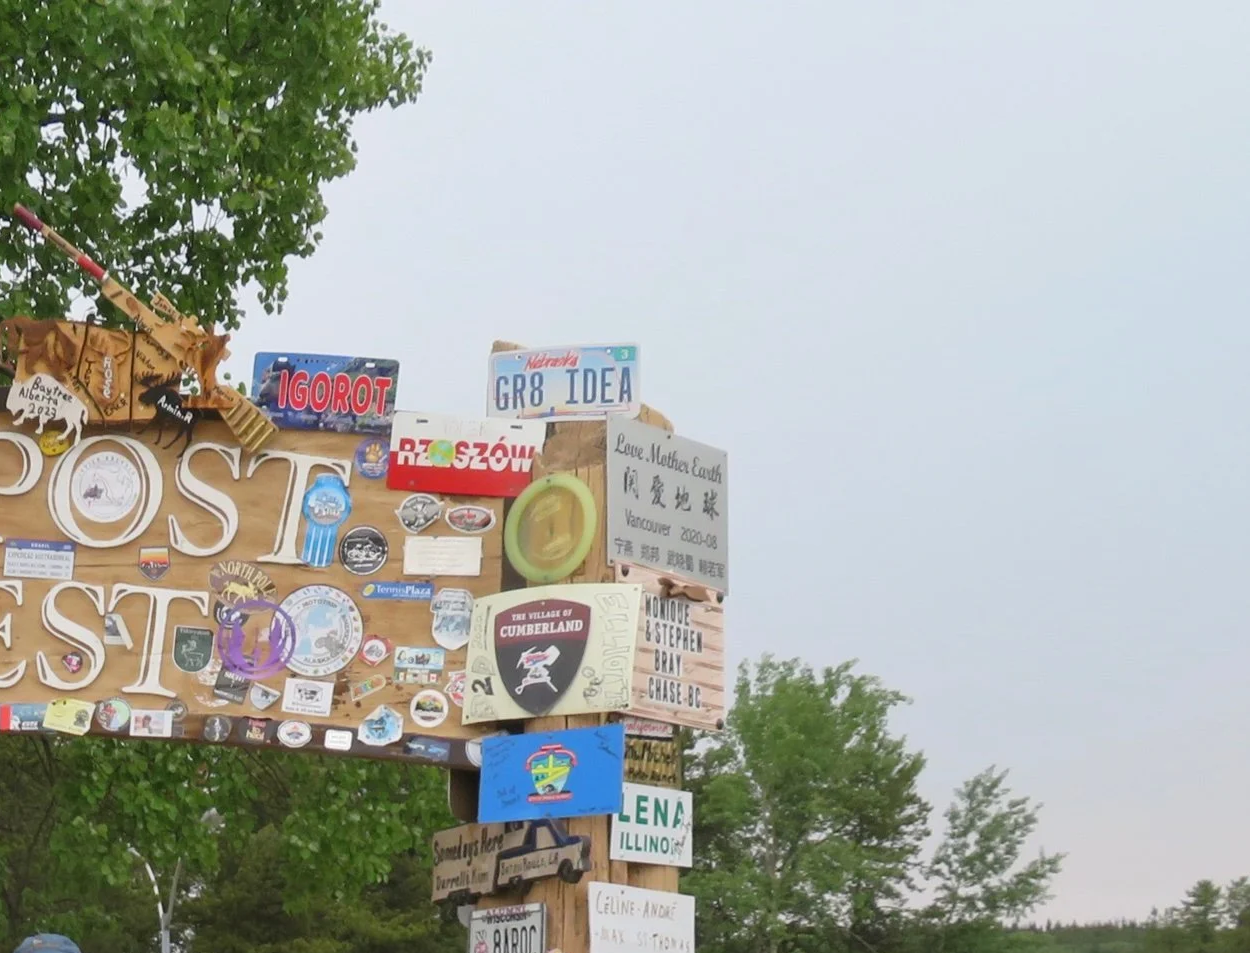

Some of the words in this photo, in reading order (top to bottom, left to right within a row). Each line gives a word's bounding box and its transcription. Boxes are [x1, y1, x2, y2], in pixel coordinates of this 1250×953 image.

[524, 351, 580, 371] Nebraska
[277, 370, 393, 417] IGOROT
[495, 375, 545, 412] GR8
[565, 367, 633, 406] IDEA
[397, 436, 536, 472] RZSZÓW
[614, 432, 644, 461] Love
[645, 443, 690, 475] Mother
[691, 456, 722, 484] Earth
[625, 508, 672, 536] Vancouver
[218, 560, 255, 583] NORTH
[253, 569, 277, 595] POLE
[511, 613, 527, 622] THE
[528, 611, 560, 621] VILLAGE
[562, 608, 573, 618] OF
[645, 594, 691, 626] MONIQUE
[500, 619, 583, 638] CUMBERLAND
[653, 619, 703, 654] STEPHEN
[654, 649, 682, 677] BRAY
[691, 686, 701, 710] BC
[618, 792, 685, 829] LENA
